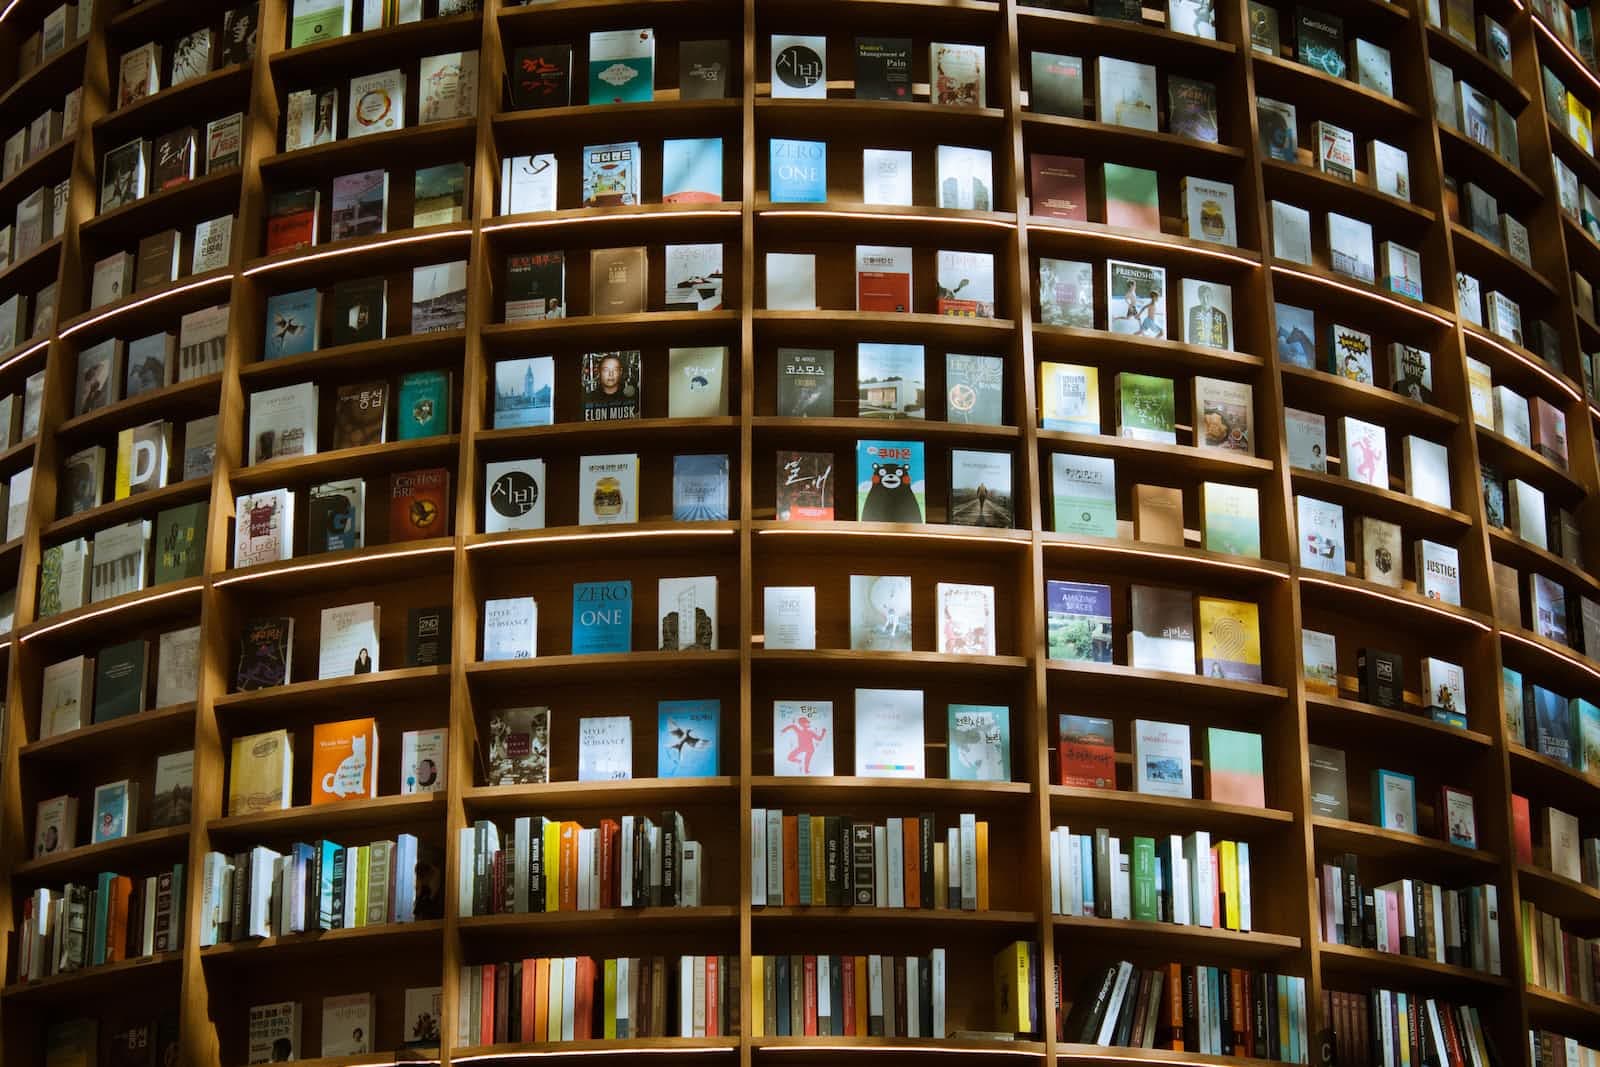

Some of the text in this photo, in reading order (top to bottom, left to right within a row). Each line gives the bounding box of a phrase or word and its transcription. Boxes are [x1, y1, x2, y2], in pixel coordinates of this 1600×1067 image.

[887, 59, 906, 68] Pain
[774, 143, 823, 160] ZERO
[1323, 135, 1336, 159] 7
[777, 166, 817, 182] ONE
[785, 365, 825, 375] 코스모스
[585, 406, 636, 421] ELON MUSK
[1426, 559, 1457, 579] JUSTICE
[576, 585, 628, 601] ZERO
[1062, 594, 1097, 604] AMAZING
[581, 610, 622, 626] ONE
